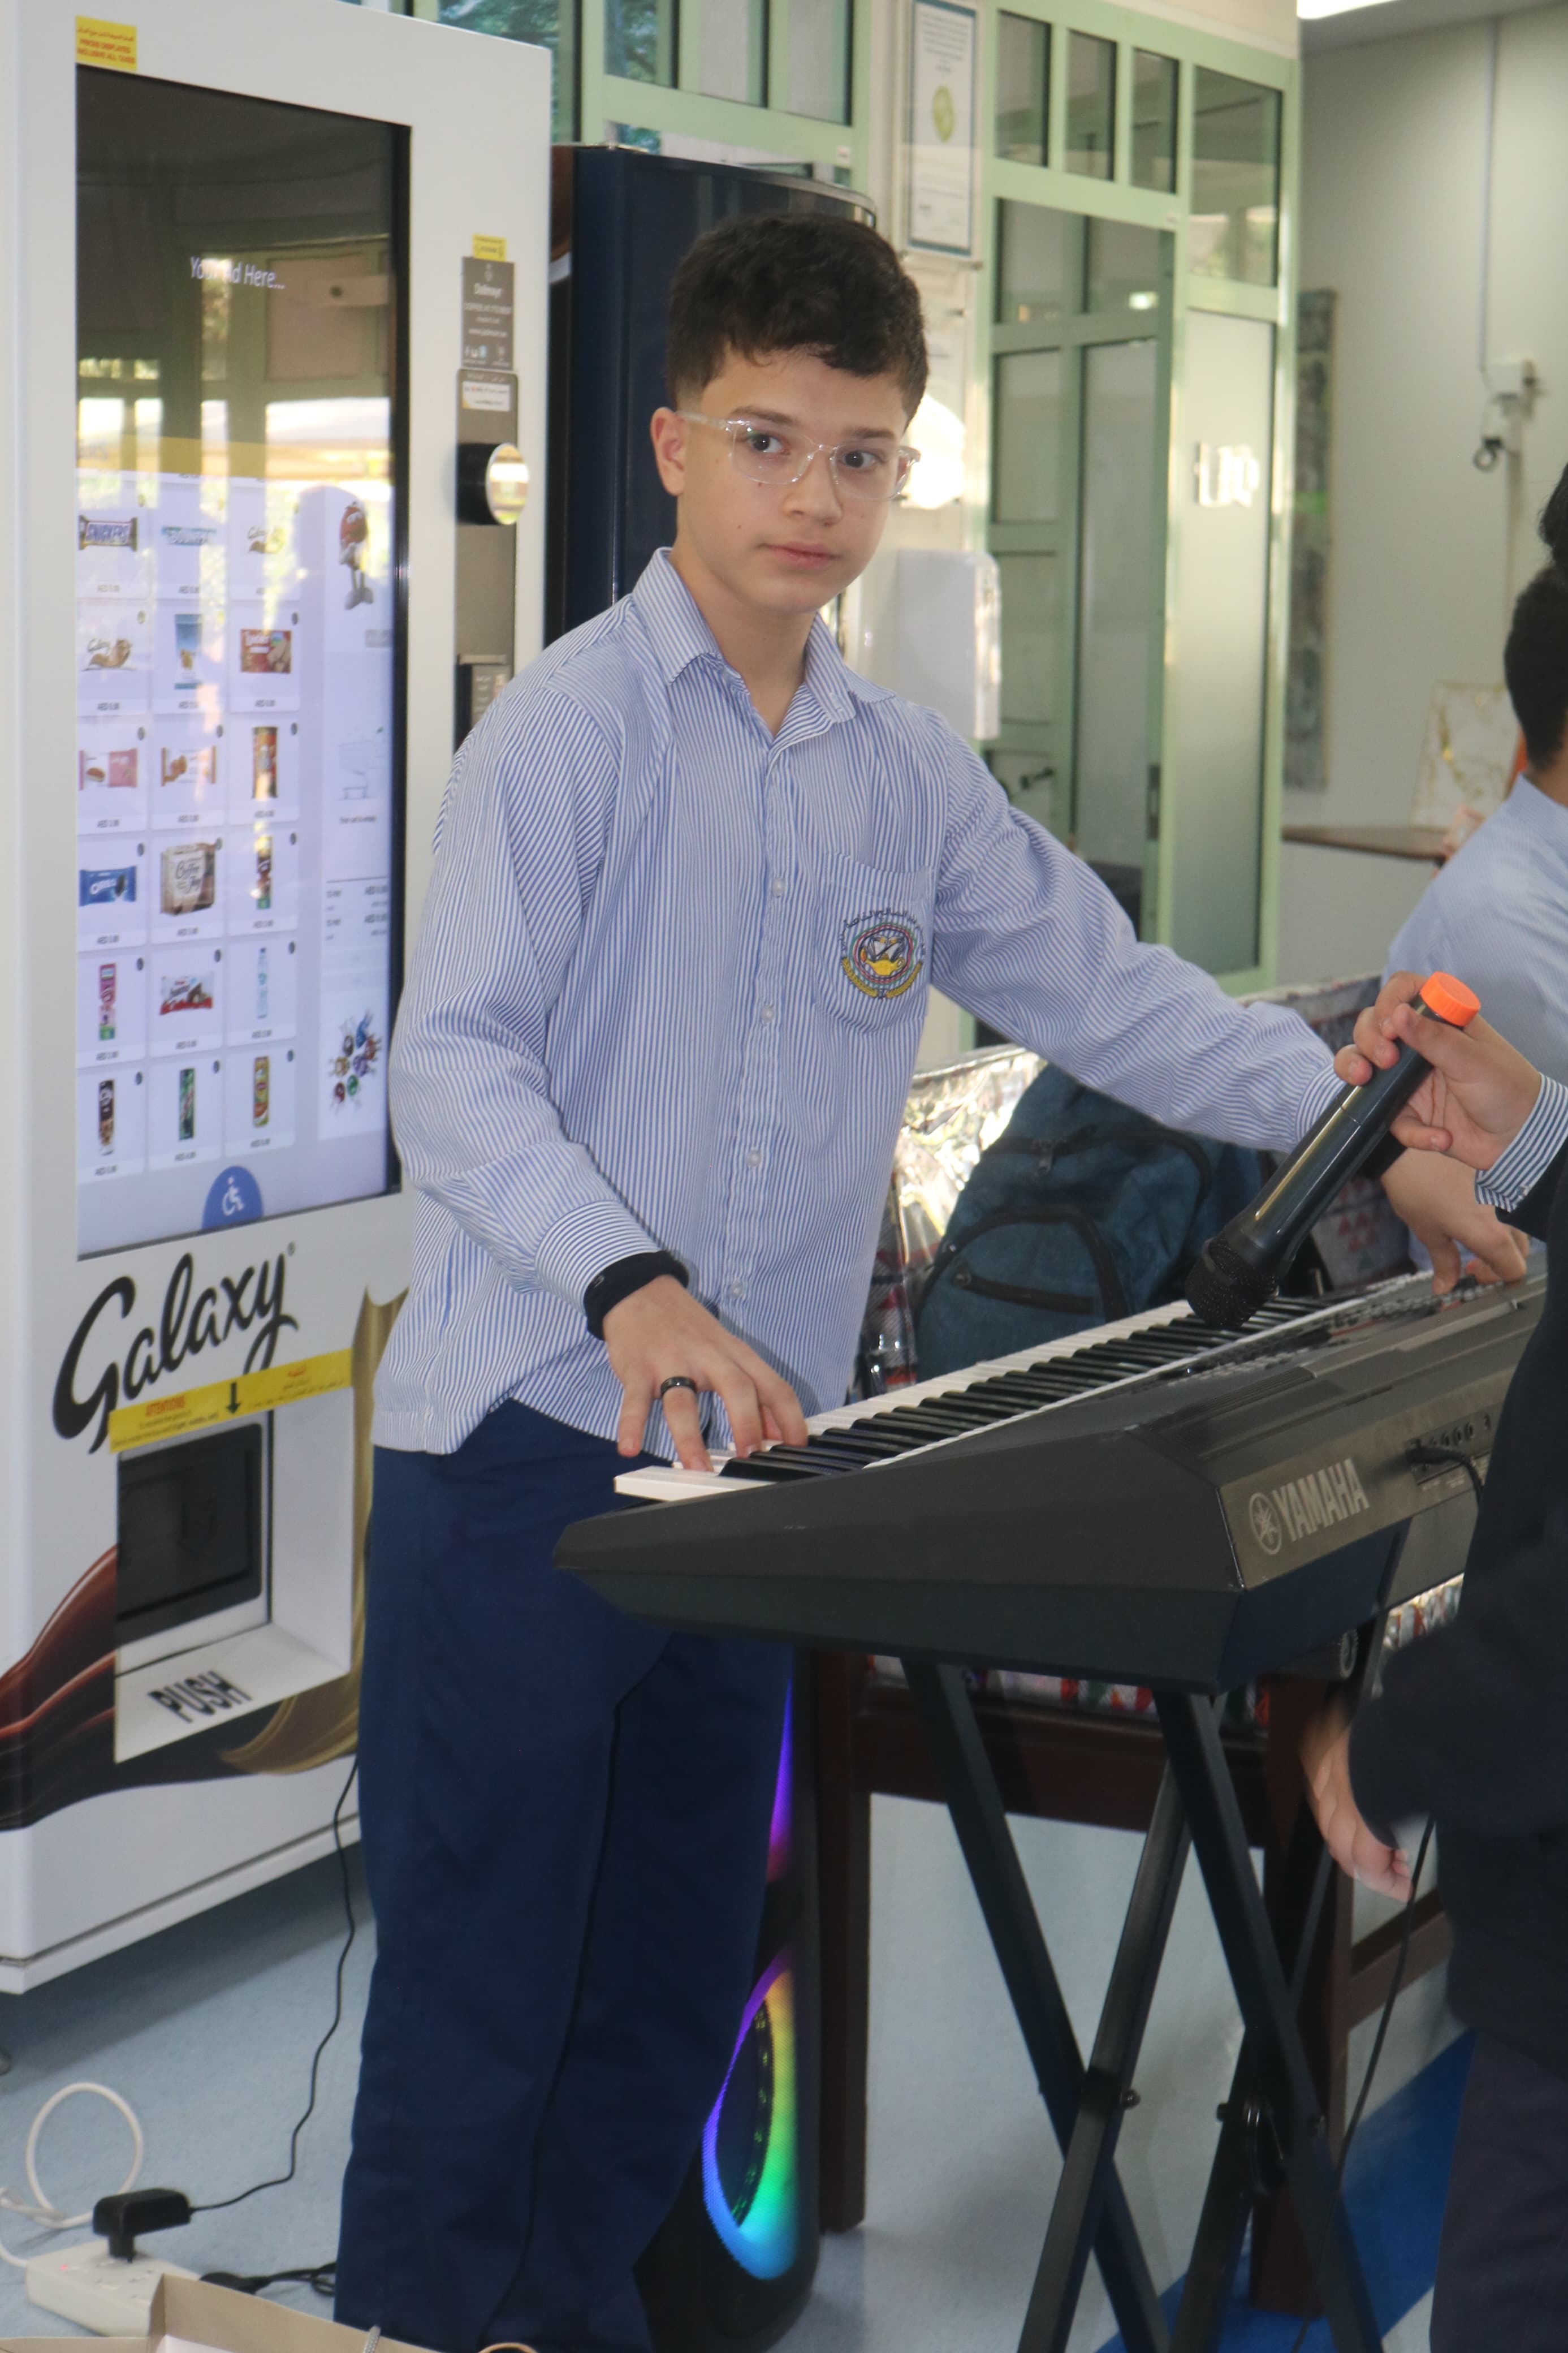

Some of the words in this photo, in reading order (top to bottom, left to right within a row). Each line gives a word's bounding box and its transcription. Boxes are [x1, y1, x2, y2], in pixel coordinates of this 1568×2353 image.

[244, 264, 285, 289] Here...
[175, 859, 201, 880] Coffee
[53, 1253, 299, 1455] Galaxy
[1272, 1457, 1371, 1542] YAMAHA
[147, 1670, 254, 1723] PUSH
